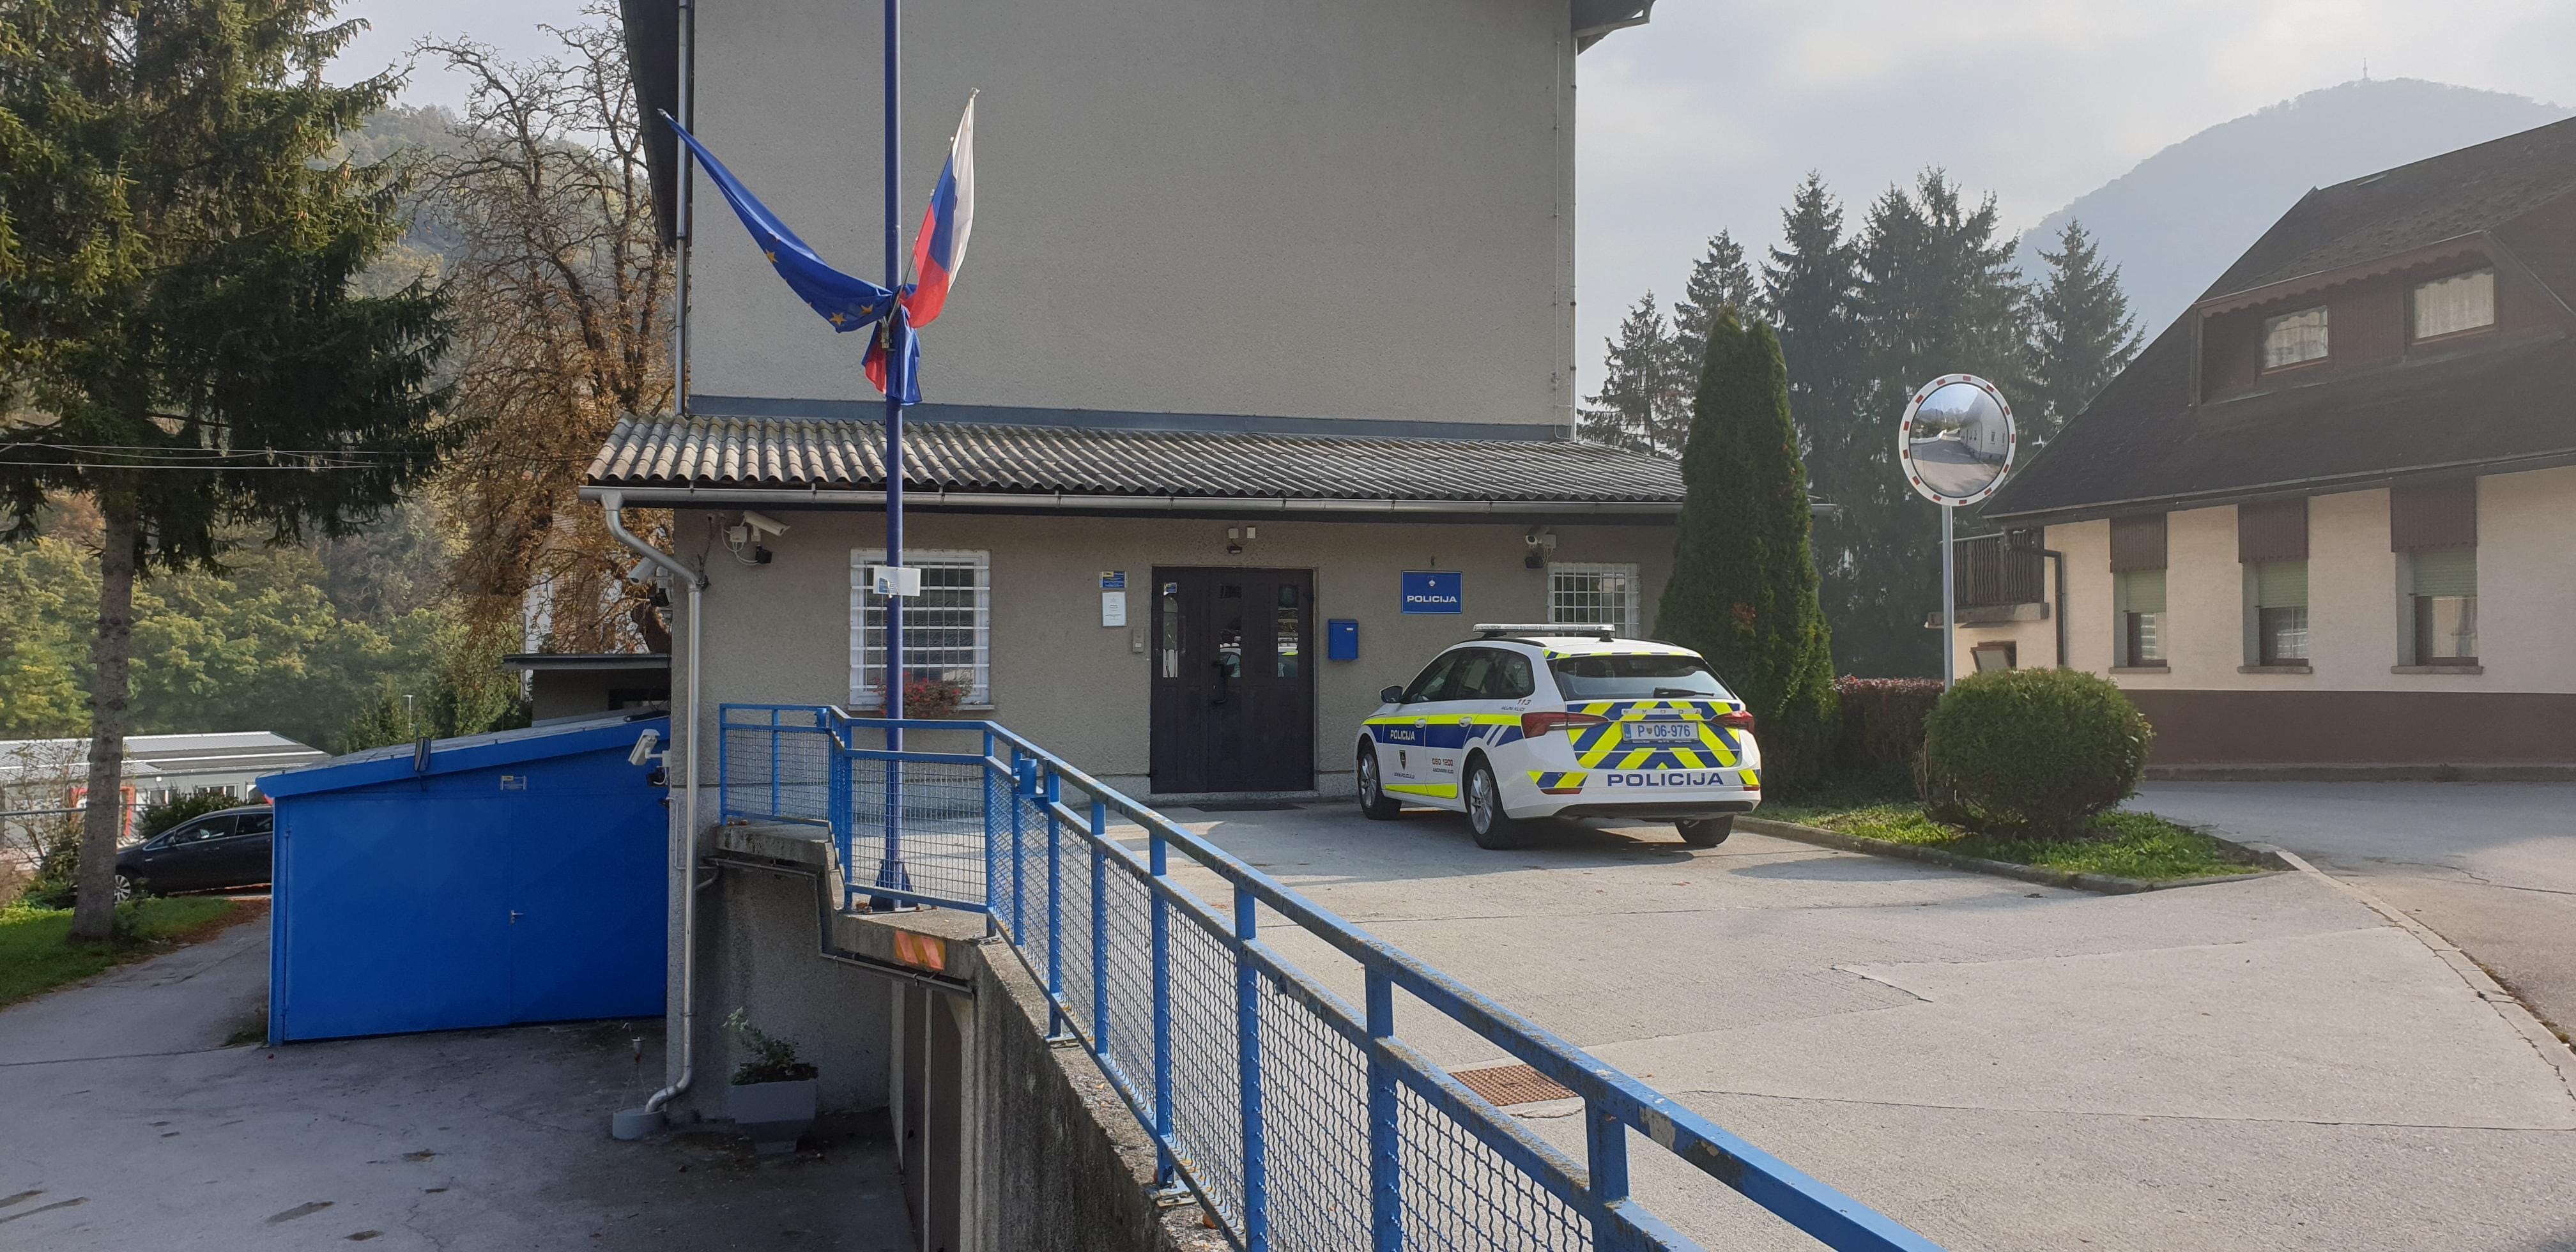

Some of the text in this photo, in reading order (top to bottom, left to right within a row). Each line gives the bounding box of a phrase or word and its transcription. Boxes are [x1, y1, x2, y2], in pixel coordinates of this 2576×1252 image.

[1390, 729, 1416, 741] POLICIJA
[1442, 758, 1453, 767] 1200
[1607, 772, 1724, 787] POLICIJA
